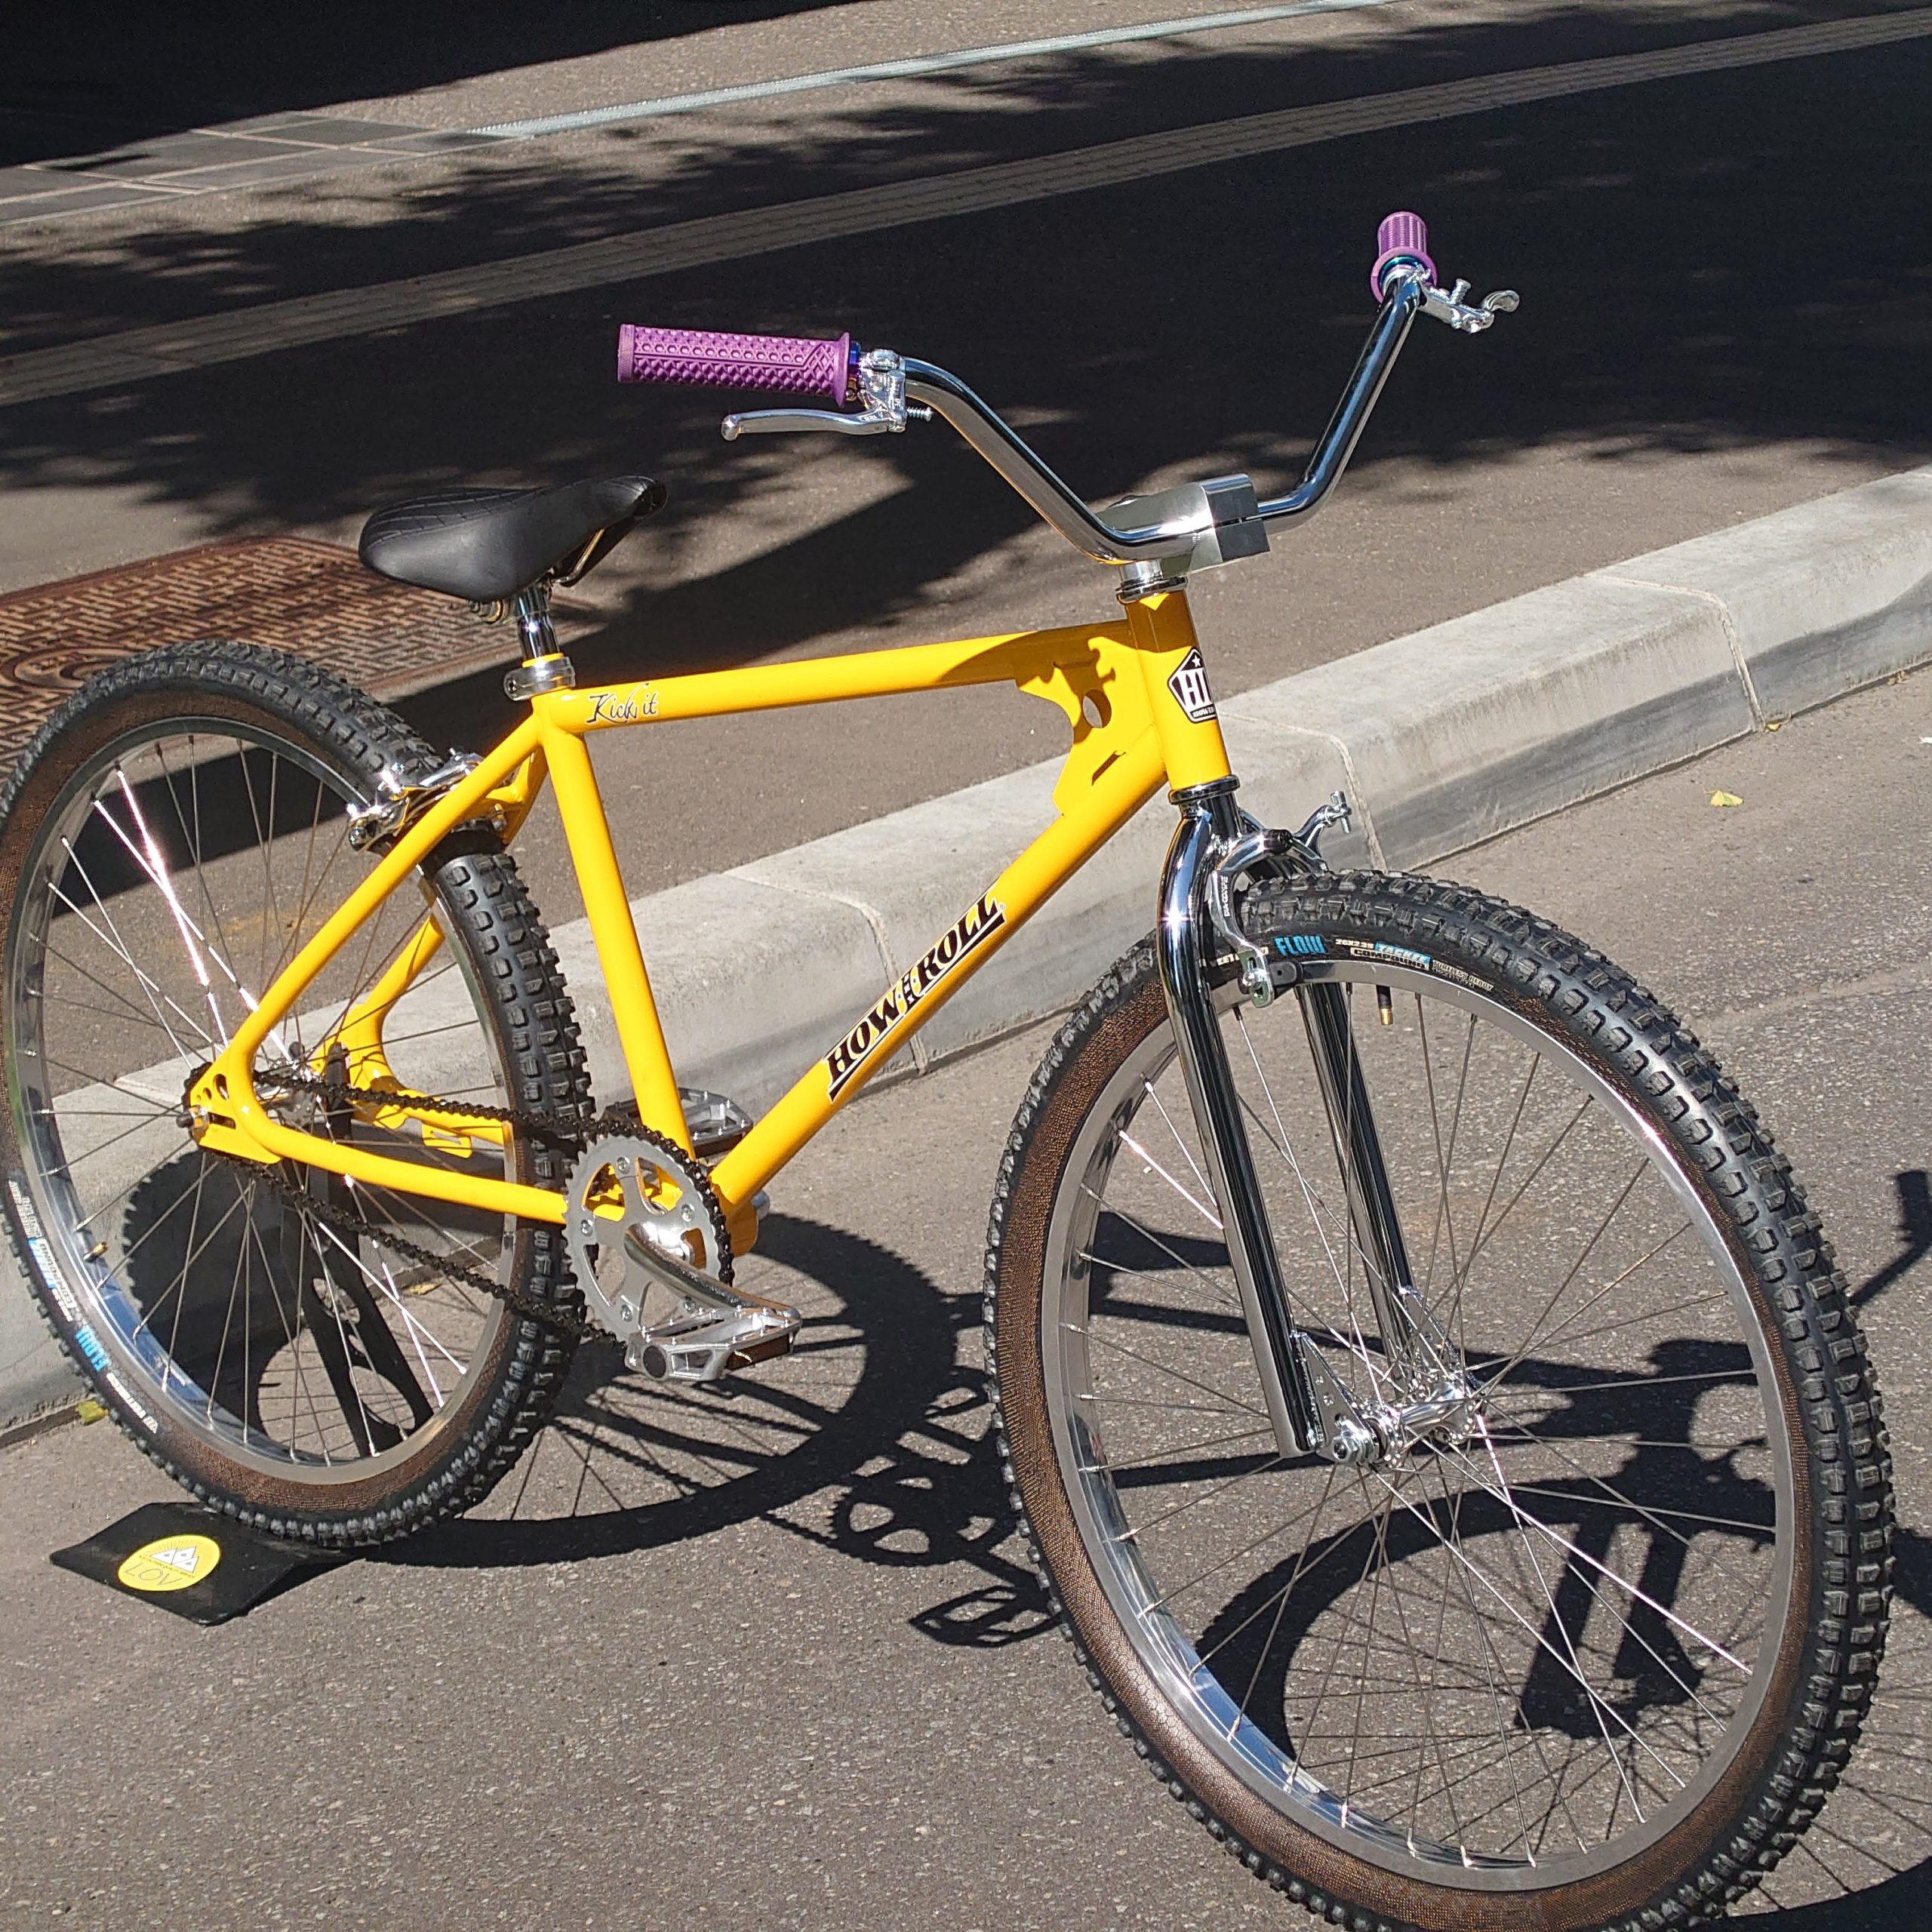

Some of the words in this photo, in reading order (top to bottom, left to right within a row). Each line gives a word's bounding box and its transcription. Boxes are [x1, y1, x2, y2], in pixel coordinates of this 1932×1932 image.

[586, 682, 649, 724] Kick
[642, 693, 657, 715] it
[1274, 935, 1327, 956] FLOW
[1353, 948, 1426, 970] COMPOUND
[827, 987, 900, 1084] HOW
[916, 893, 998, 995] ROLL
[75, 1324, 109, 1372] FLOW
